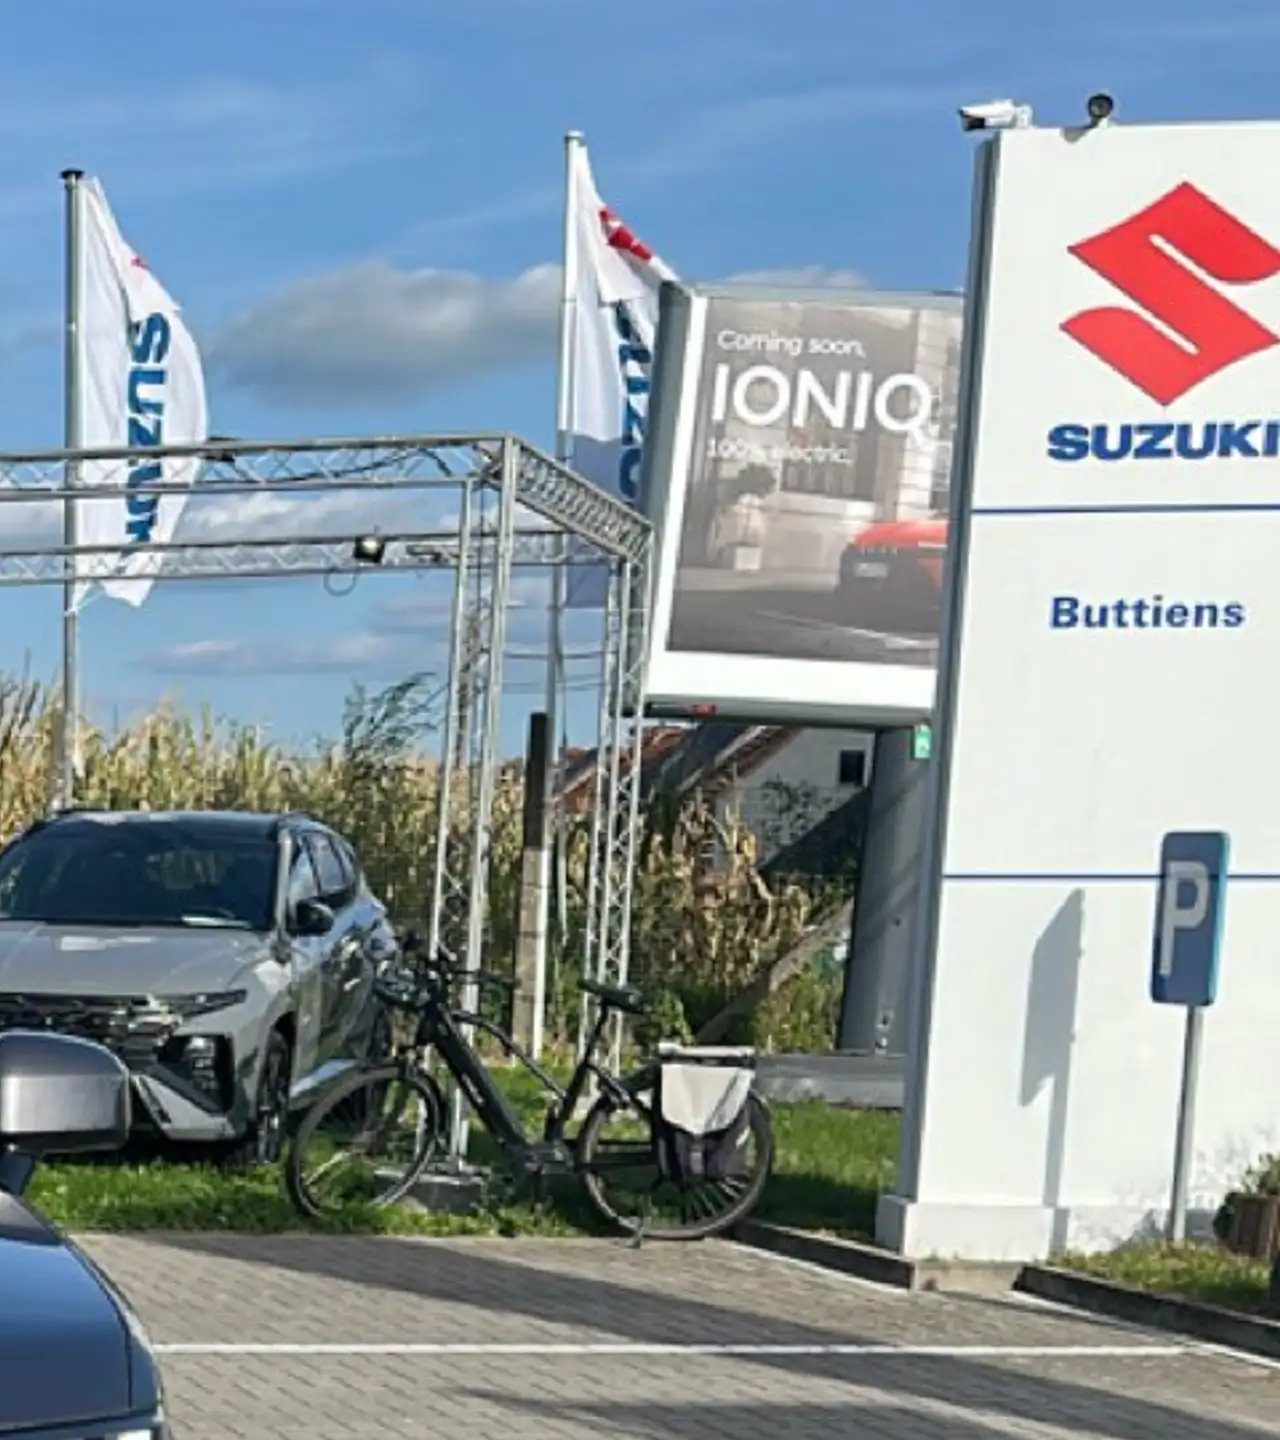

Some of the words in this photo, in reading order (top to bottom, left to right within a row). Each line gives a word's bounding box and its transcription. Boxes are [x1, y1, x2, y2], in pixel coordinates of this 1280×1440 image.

[717, 329, 803, 356] Coming
[711, 362, 933, 447] IONIQ
[1047, 421, 1280, 460] SUZUKI
[1051, 594, 1247, 629] Buttiens
[1158, 860, 1209, 976] P
